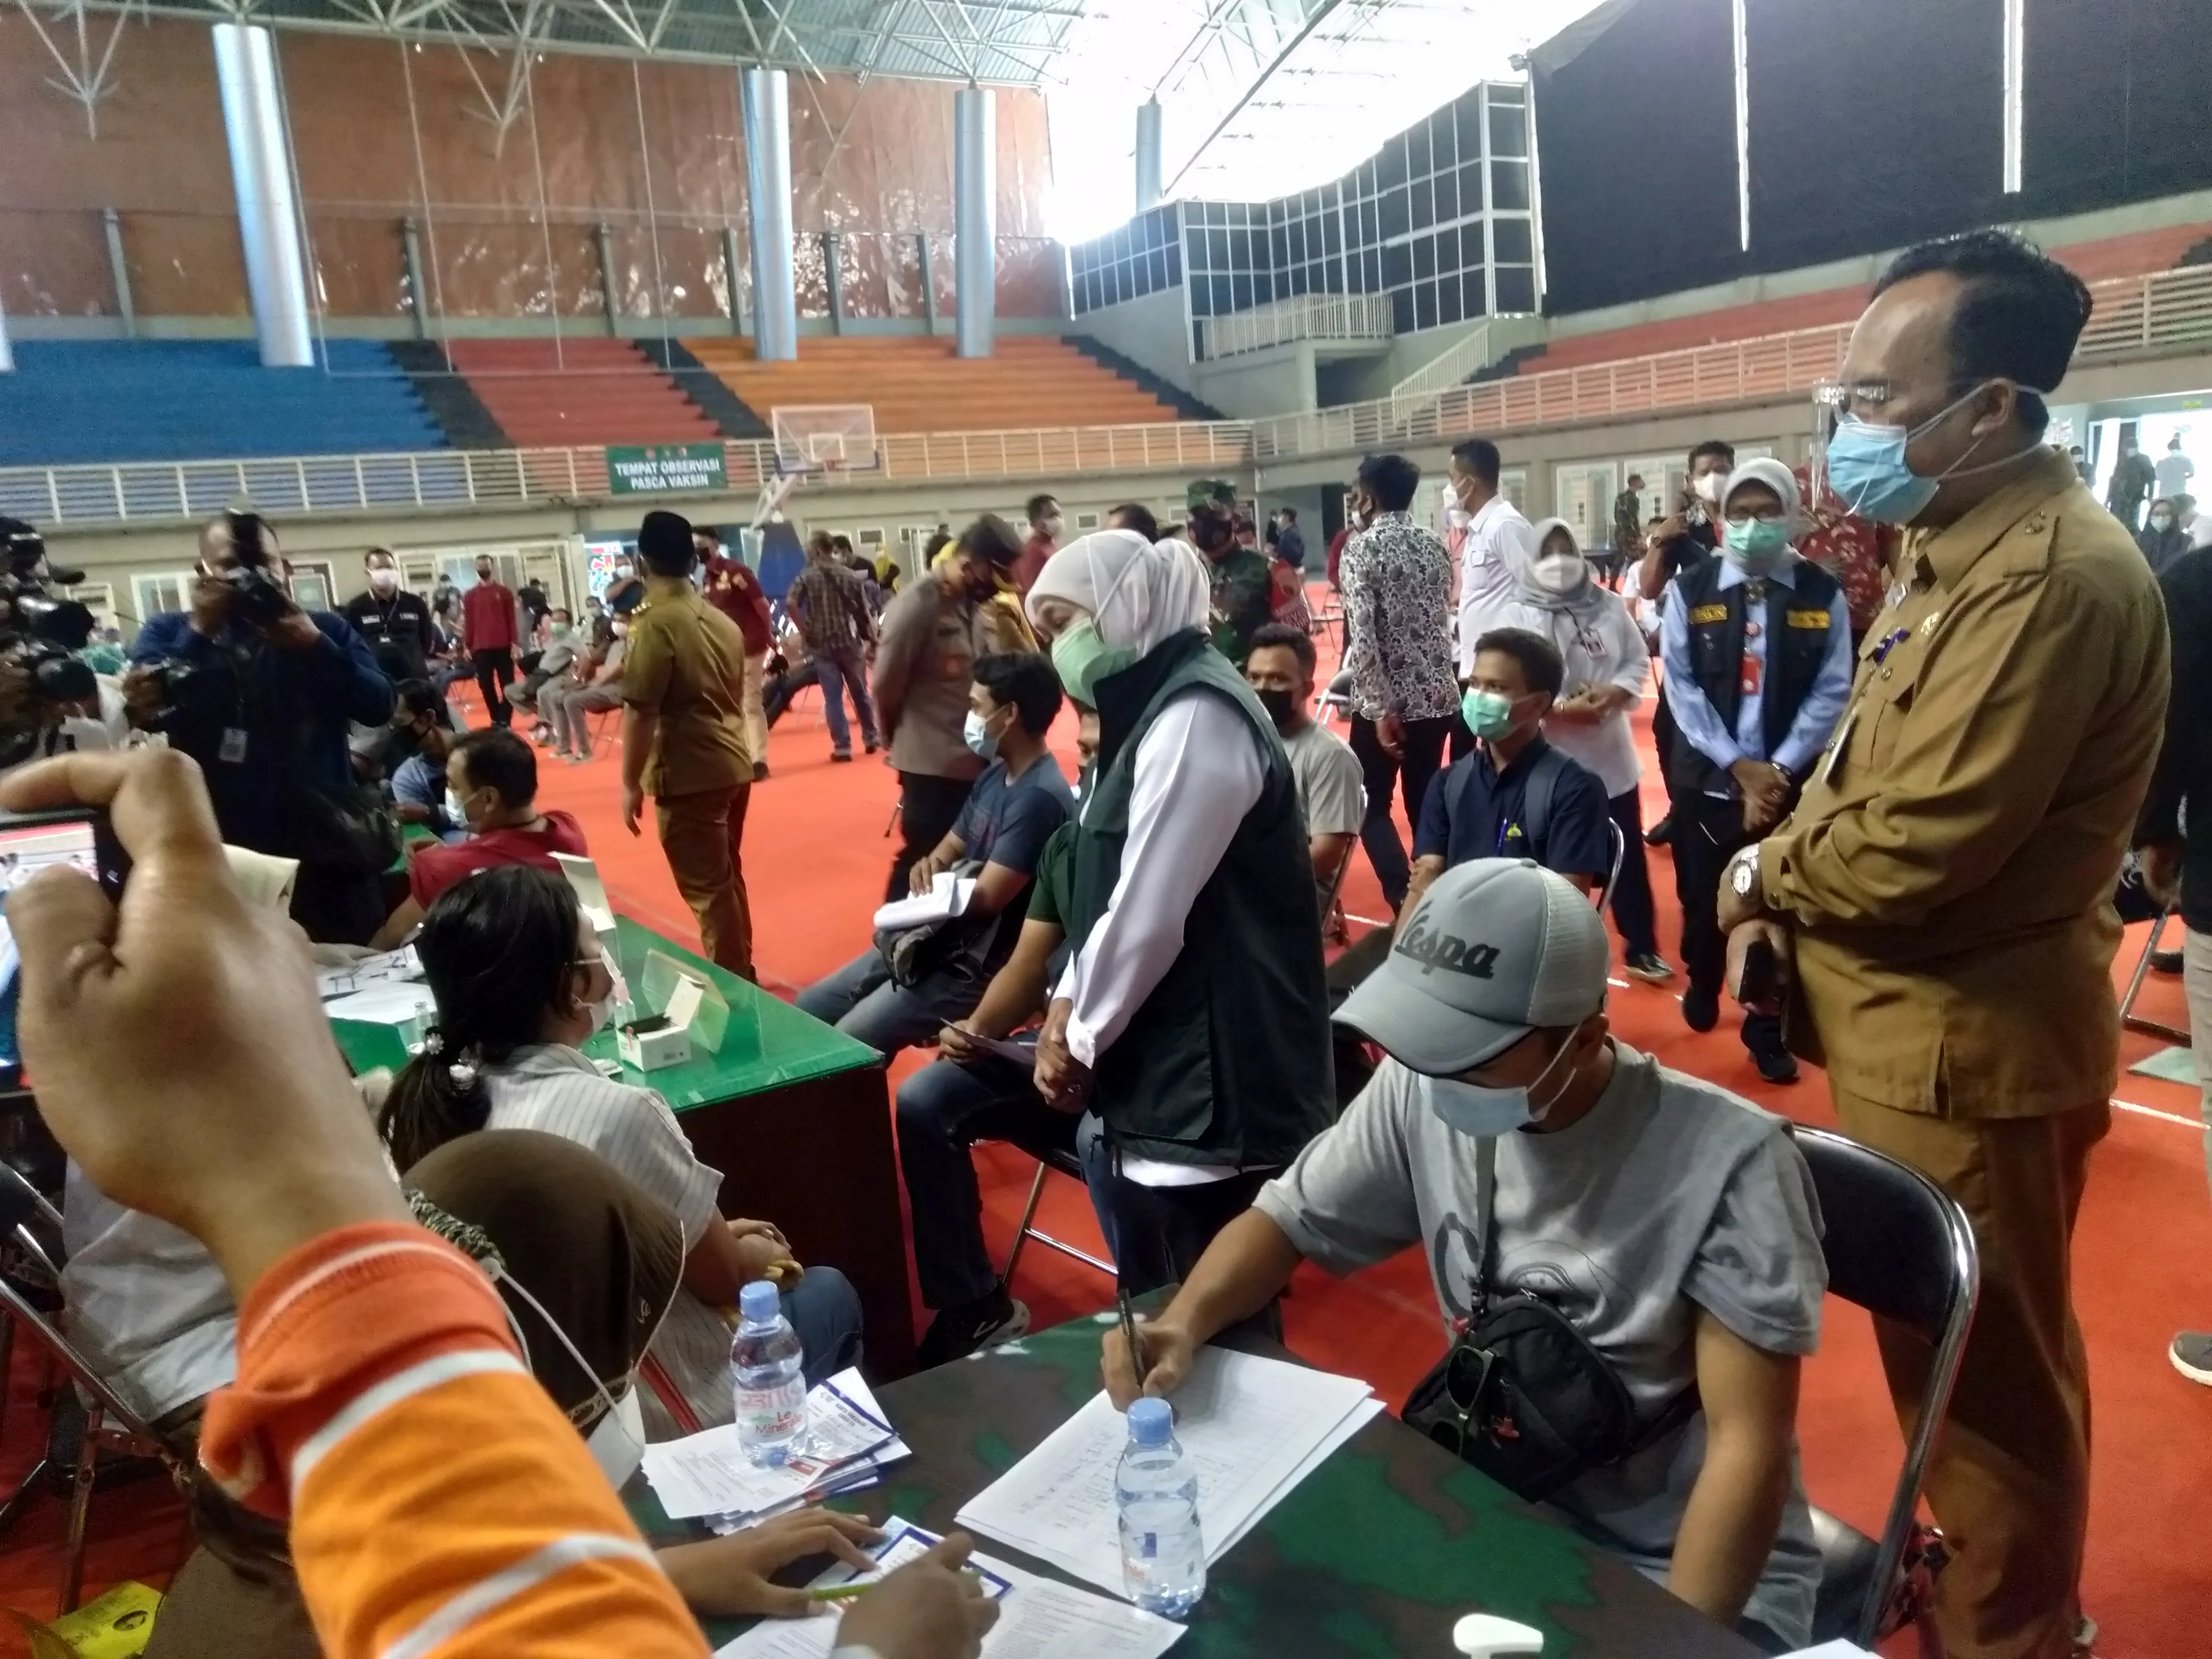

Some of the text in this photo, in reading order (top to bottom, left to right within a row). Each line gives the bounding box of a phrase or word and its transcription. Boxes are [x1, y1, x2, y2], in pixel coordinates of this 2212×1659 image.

[615, 458, 720, 476] TEMPAT OBSERVASI
[630, 474, 709, 490] PASCA VAKSIN
[1394, 900, 1501, 978] Vespa
[755, 1413, 802, 1435] Minerale
[777, 1411, 791, 1422] Le
